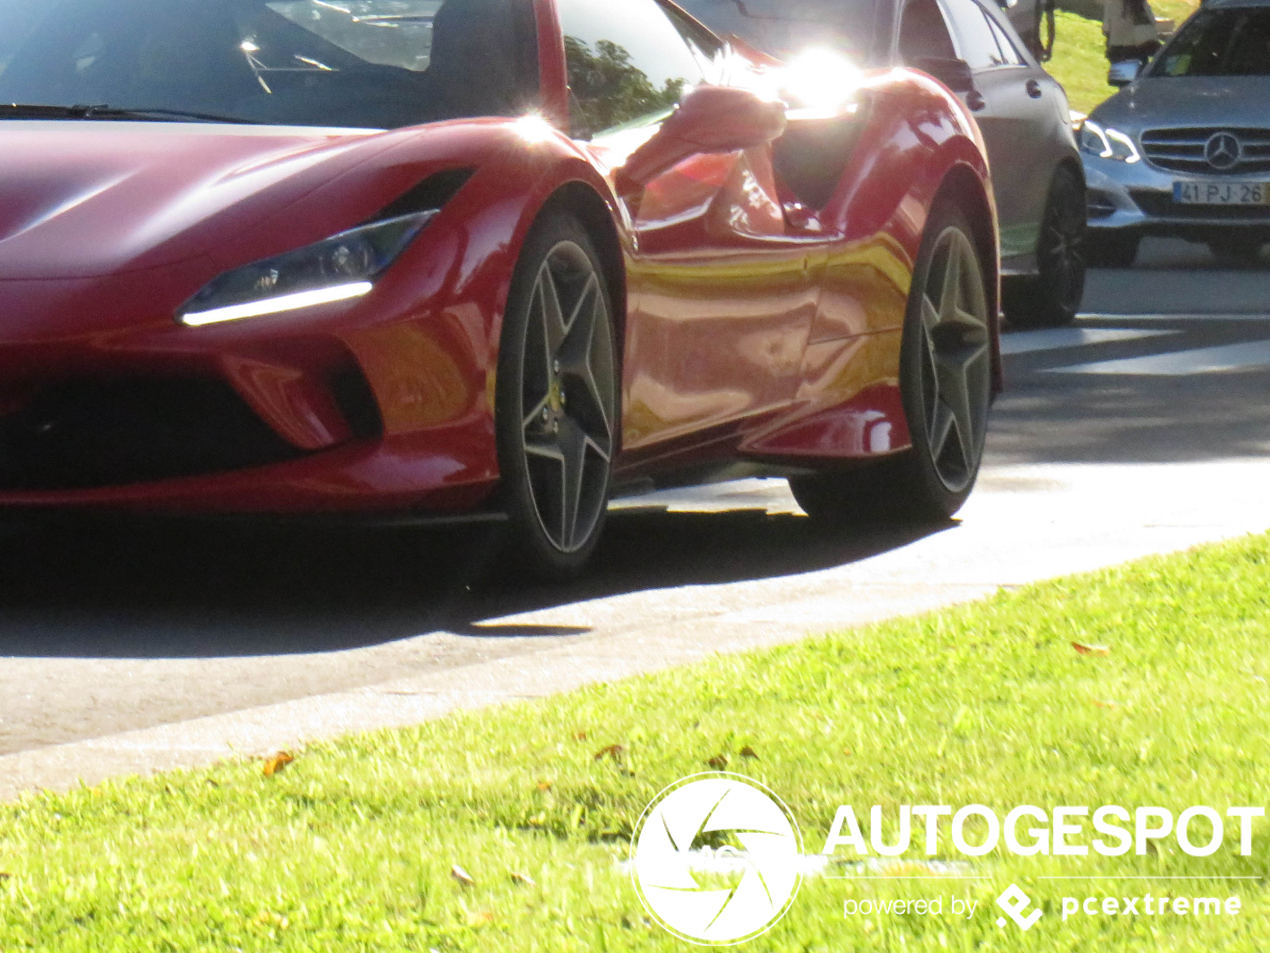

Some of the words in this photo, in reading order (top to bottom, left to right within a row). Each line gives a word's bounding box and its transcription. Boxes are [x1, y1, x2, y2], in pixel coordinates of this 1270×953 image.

[1183, 184, 1198, 201] 41
[1207, 185, 1231, 202] PJ
[1240, 185, 1263, 202] 26
